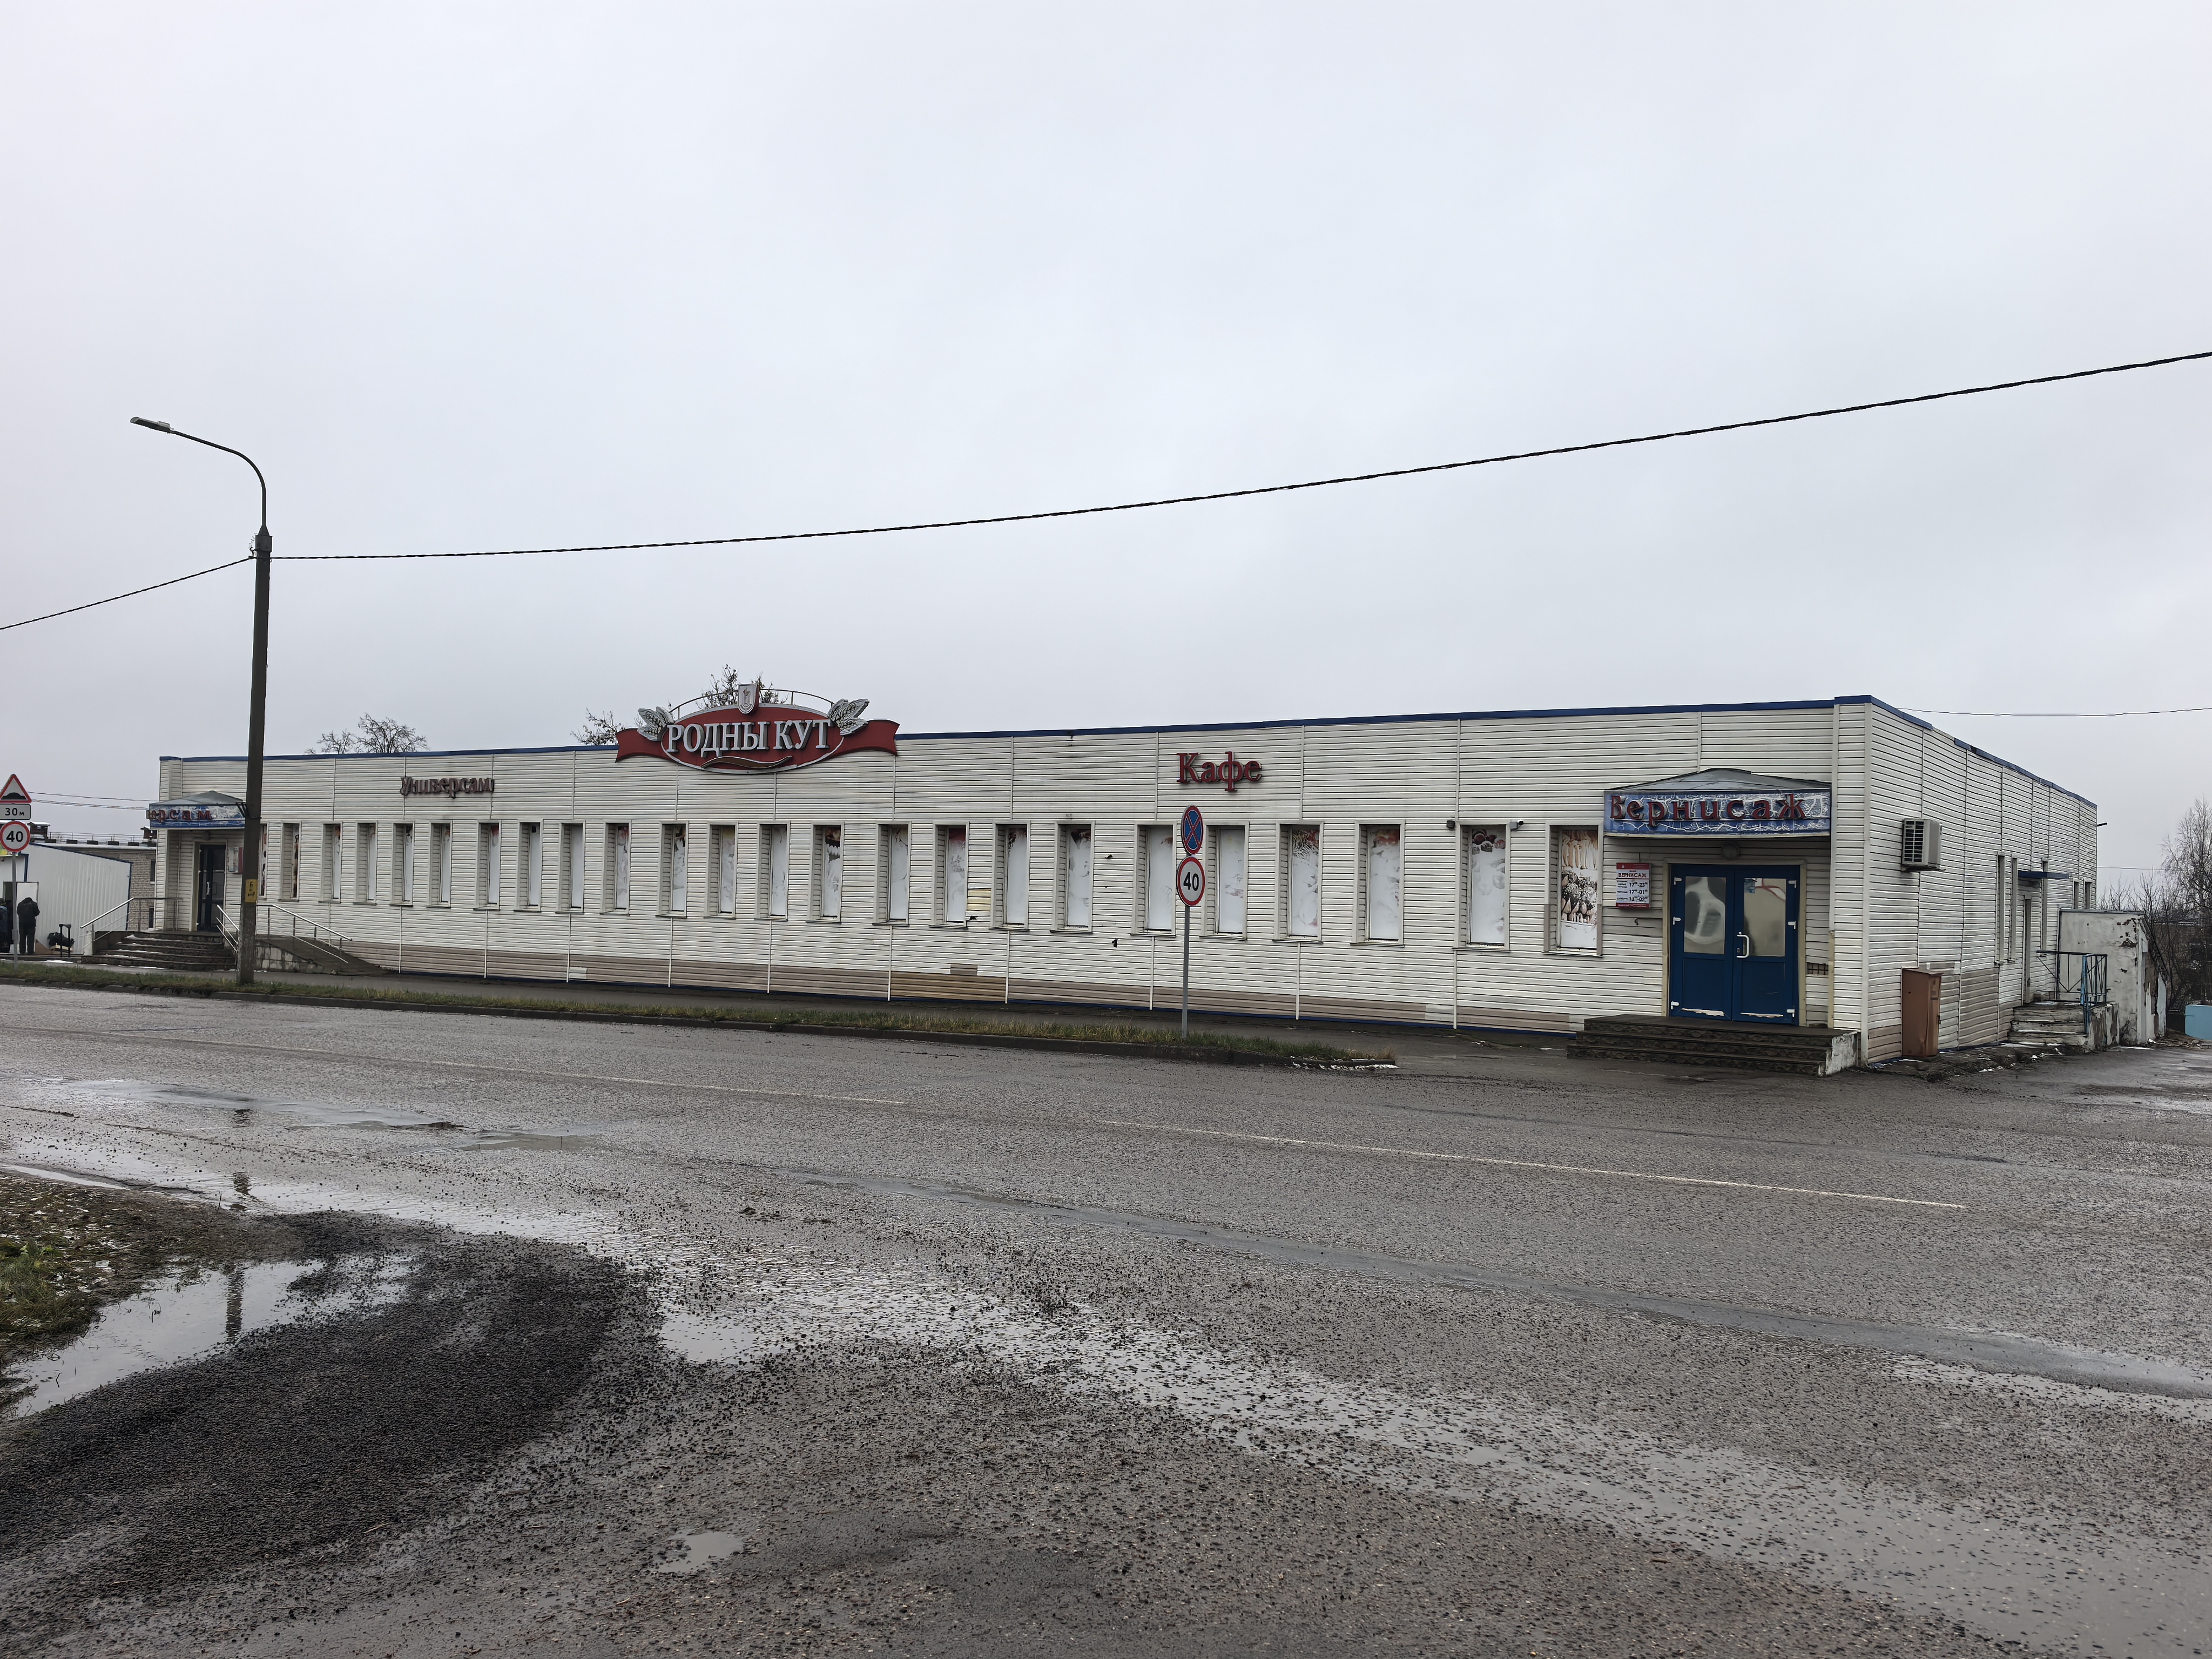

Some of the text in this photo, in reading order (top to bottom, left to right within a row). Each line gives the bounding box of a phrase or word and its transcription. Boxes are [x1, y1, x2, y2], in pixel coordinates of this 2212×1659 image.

[666, 719, 831, 757] РОДНЫ КУТ
[1176, 751, 1262, 792] Кафе
[400, 777, 495, 798] Универсам
[146, 810, 212, 823] ерсам
[1610, 793, 1806, 827] Вернисаж
[6, 831, 23, 842] 40
[1183, 872, 1199, 891] 40
